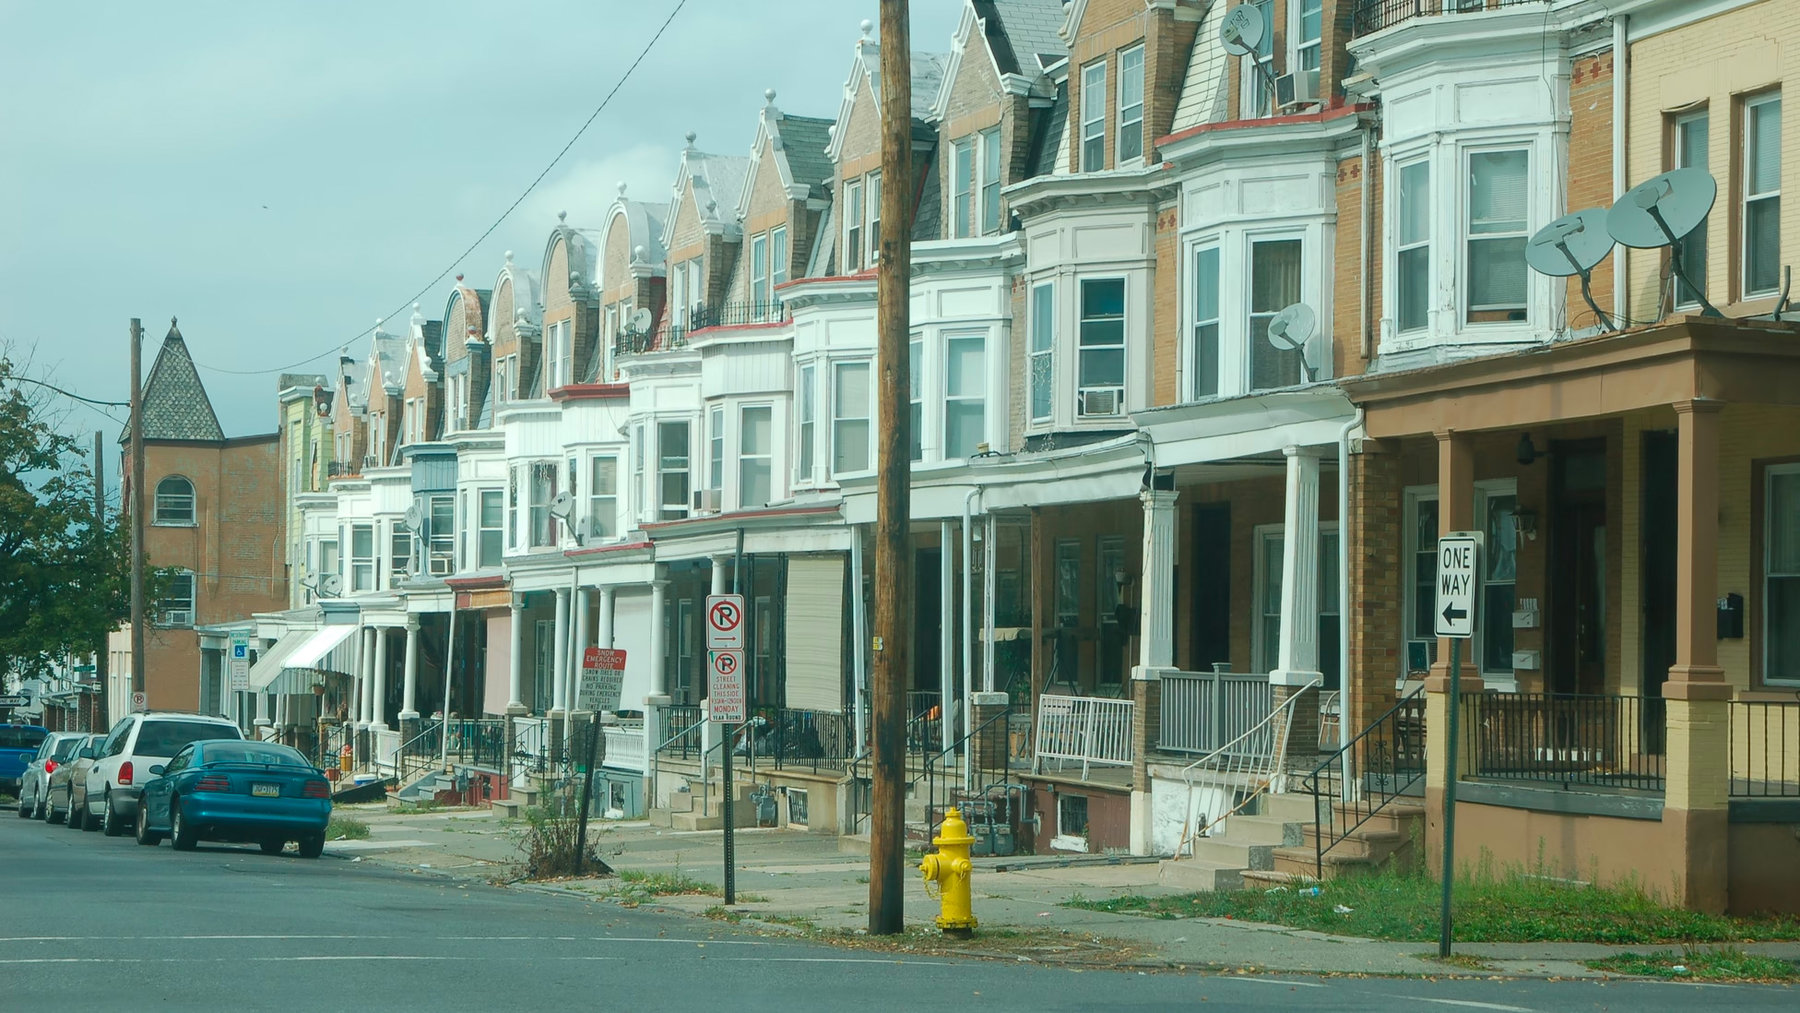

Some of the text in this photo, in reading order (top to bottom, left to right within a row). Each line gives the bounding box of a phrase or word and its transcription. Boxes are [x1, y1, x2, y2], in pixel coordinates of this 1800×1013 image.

[1443, 547, 1470, 569] ONE
[1441, 574, 1470, 596] WAY
[586, 655, 624, 664] EMERGENCY
[595, 683, 617, 691] PARKING
[714, 705, 739, 713] MONDAY
